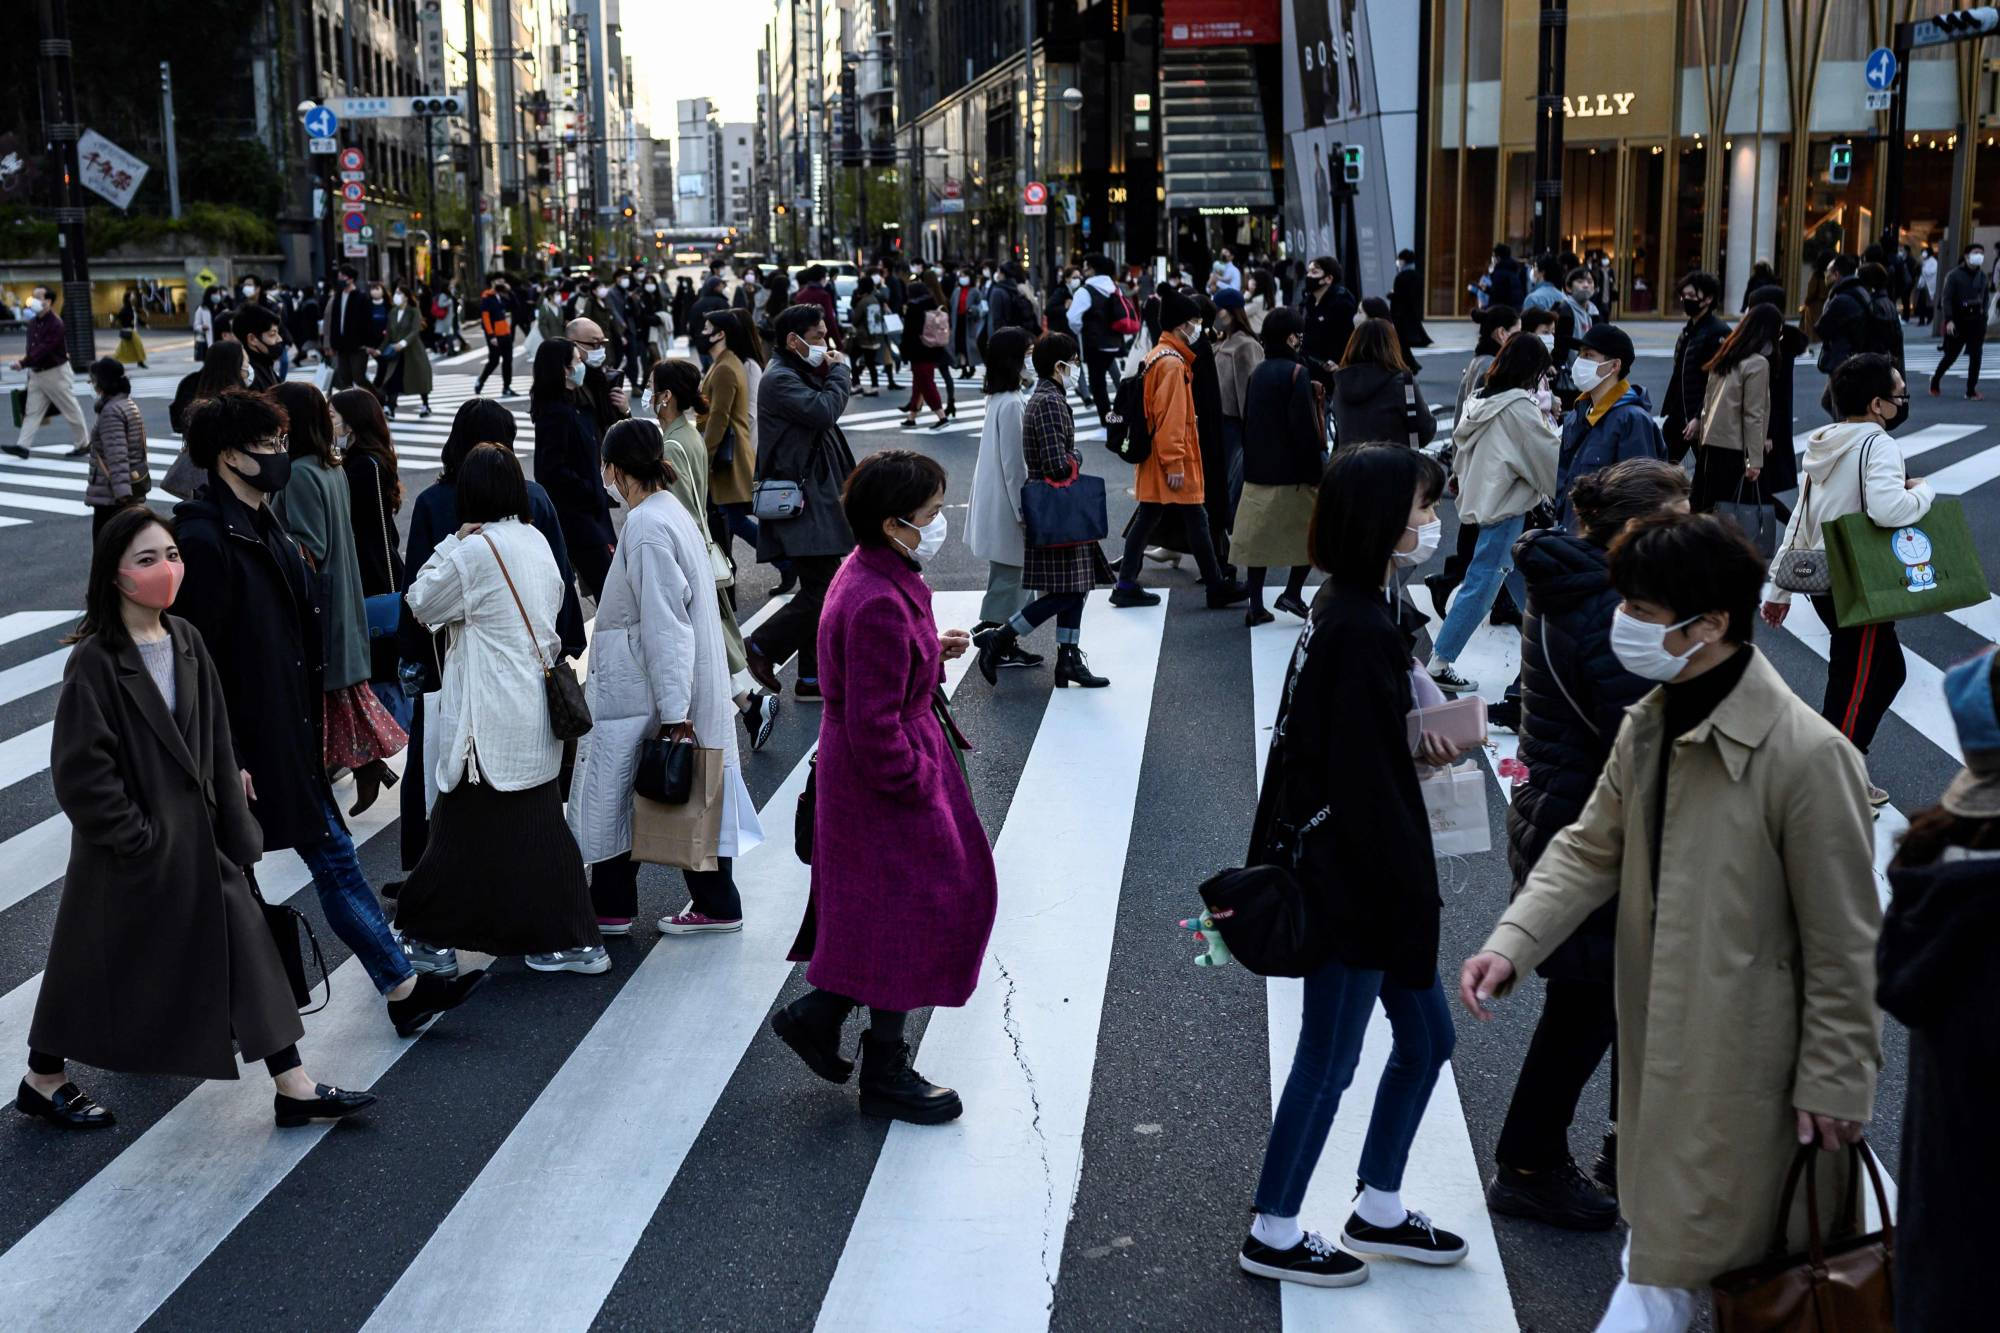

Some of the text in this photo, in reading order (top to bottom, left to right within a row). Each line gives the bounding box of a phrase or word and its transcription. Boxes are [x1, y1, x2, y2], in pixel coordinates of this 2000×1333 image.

[1304, 30, 1355, 72] BOSS
[1547, 91, 1636, 119] ALLY
[1285, 226, 1330, 253] BOSS
[1310, 804, 1332, 827] BOY
[404, 944, 413, 955] N
[553, 951, 564, 960] N
